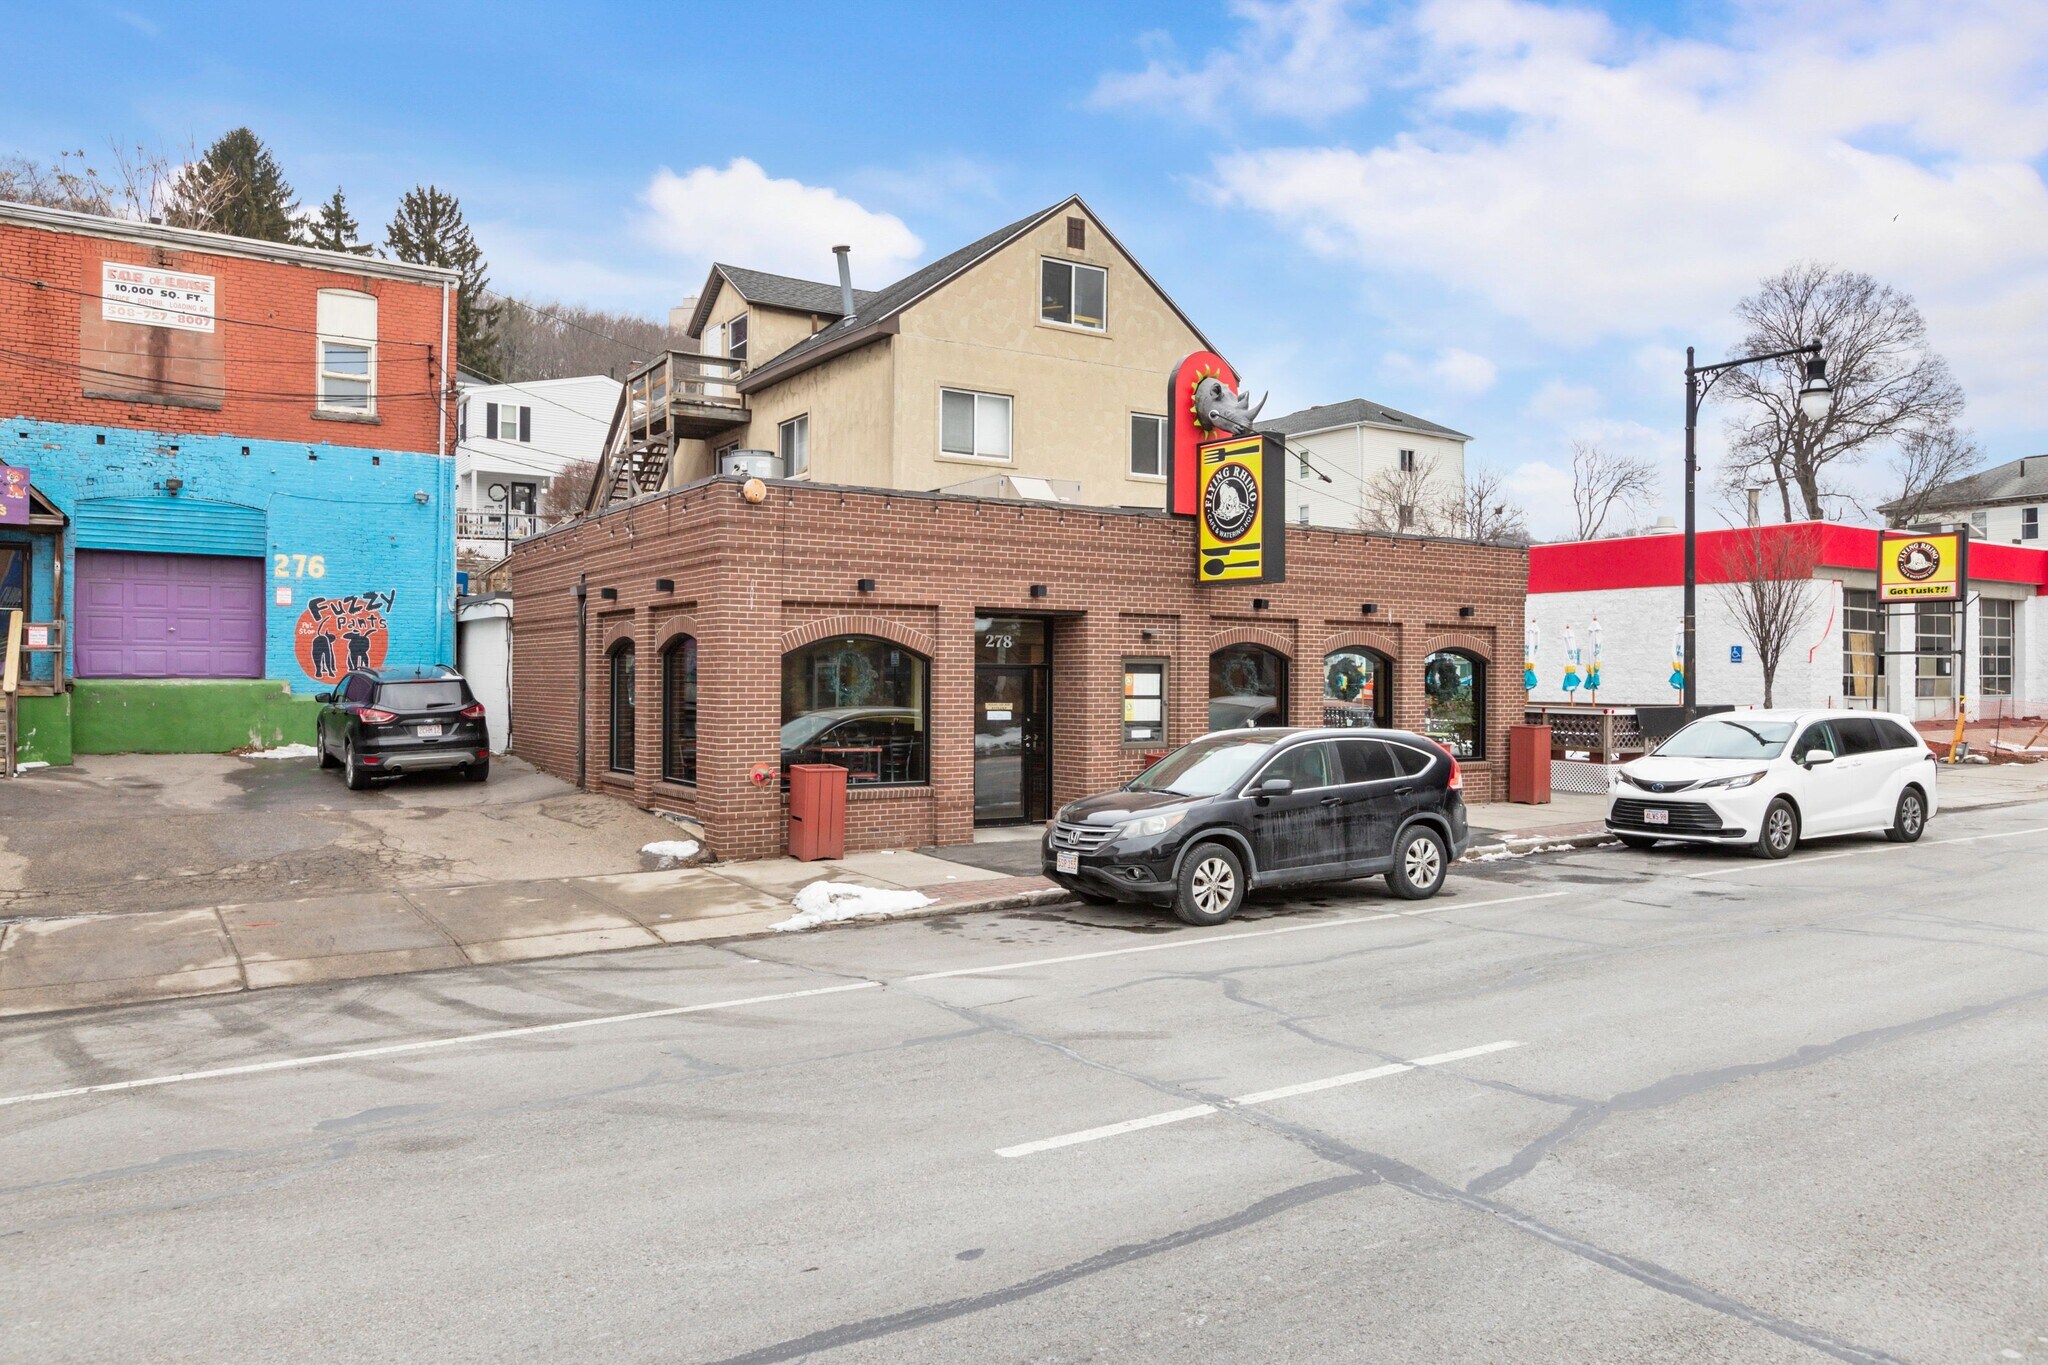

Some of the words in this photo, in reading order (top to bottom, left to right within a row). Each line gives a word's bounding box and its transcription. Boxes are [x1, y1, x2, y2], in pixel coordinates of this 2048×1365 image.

[115, 284, 154, 295] 10,000
[160, 290, 180, 300] SQ.
[186, 293, 204, 303] FT.
[107, 306, 211, 327] 508-757-8007
[1205, 466, 1230, 508] FLYING
[1233, 466, 1258, 502] RHINO
[1207, 513, 1217, 531] CAFE
[1219, 526, 1245, 539] WATERING
[1243, 509, 1255, 528] HOLE
[1898, 542, 1919, 562] FLYING
[1921, 542, 1939, 559] RHINO
[274, 553, 325, 578] 276
[985, 634, 1013, 649] 278
